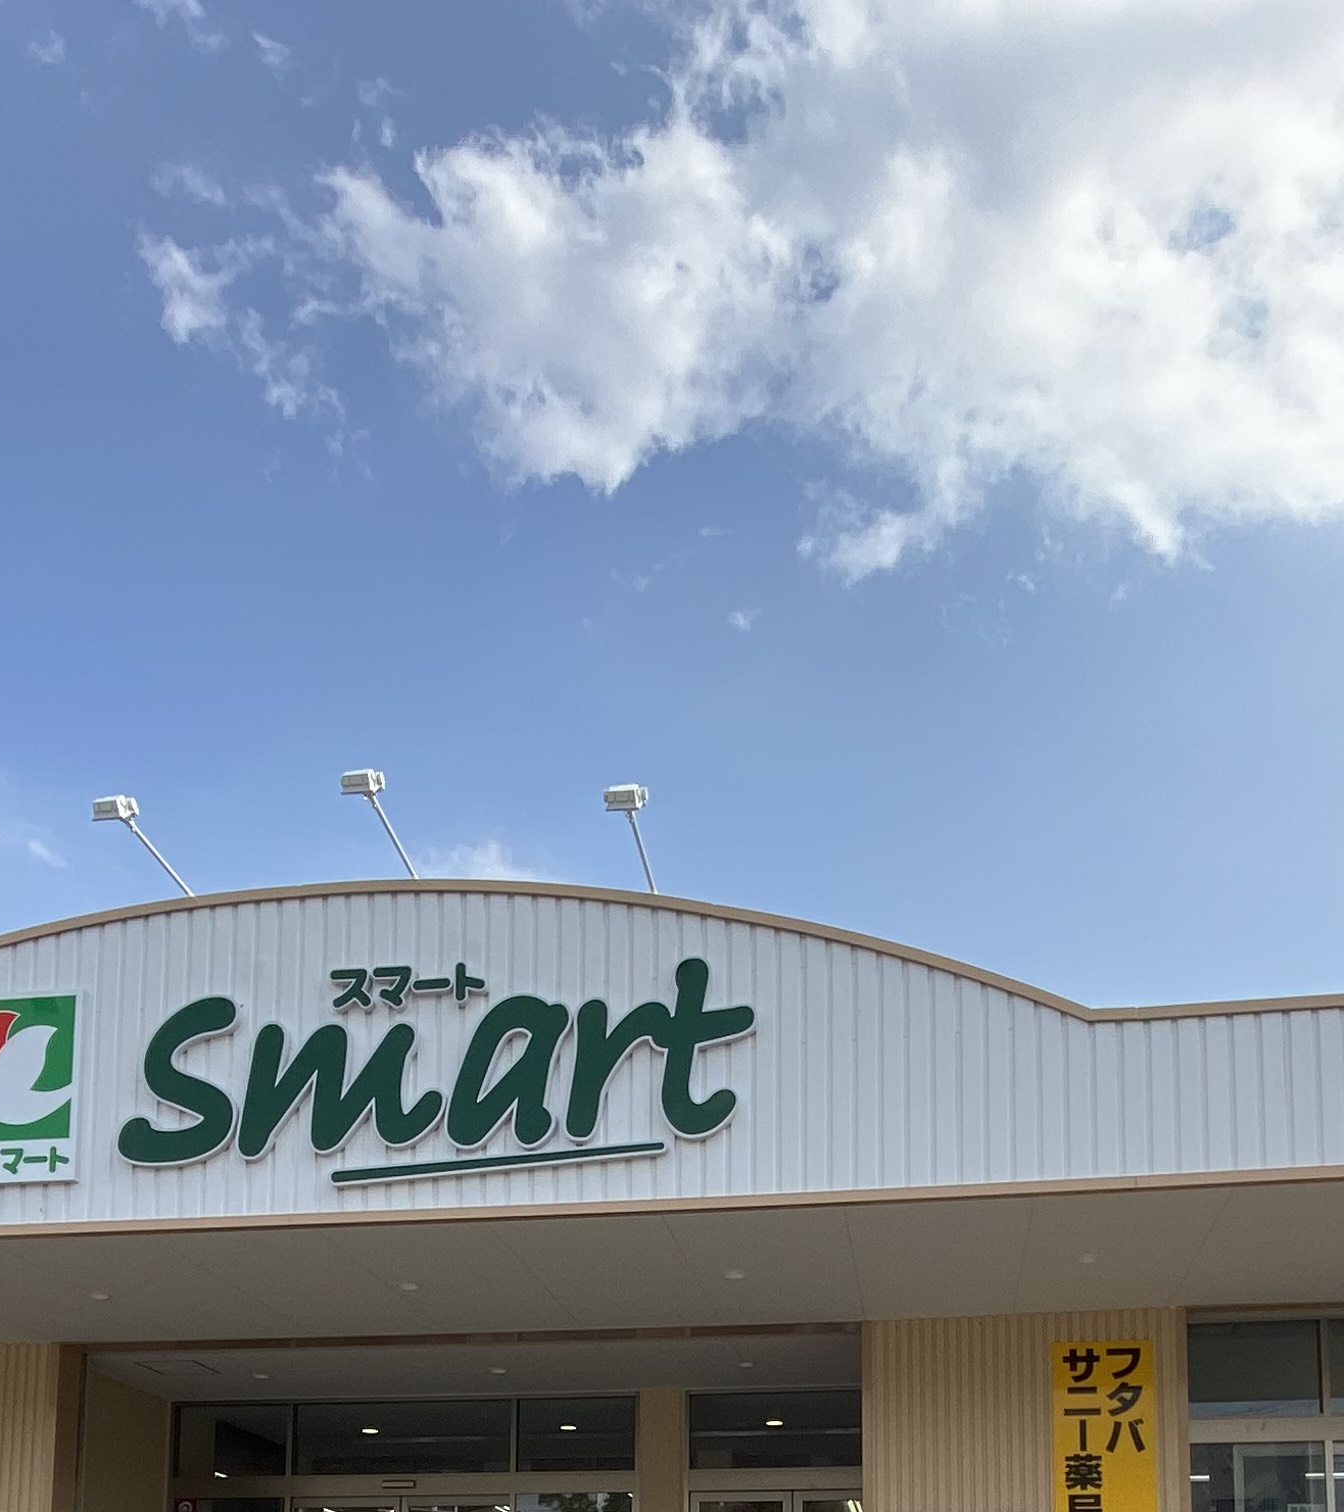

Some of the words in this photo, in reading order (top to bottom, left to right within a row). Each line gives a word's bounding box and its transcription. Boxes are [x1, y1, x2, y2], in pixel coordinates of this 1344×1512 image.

[330, 962, 487, 1011] スマート
[1105, 1347, 1146, 1453] フタバ
